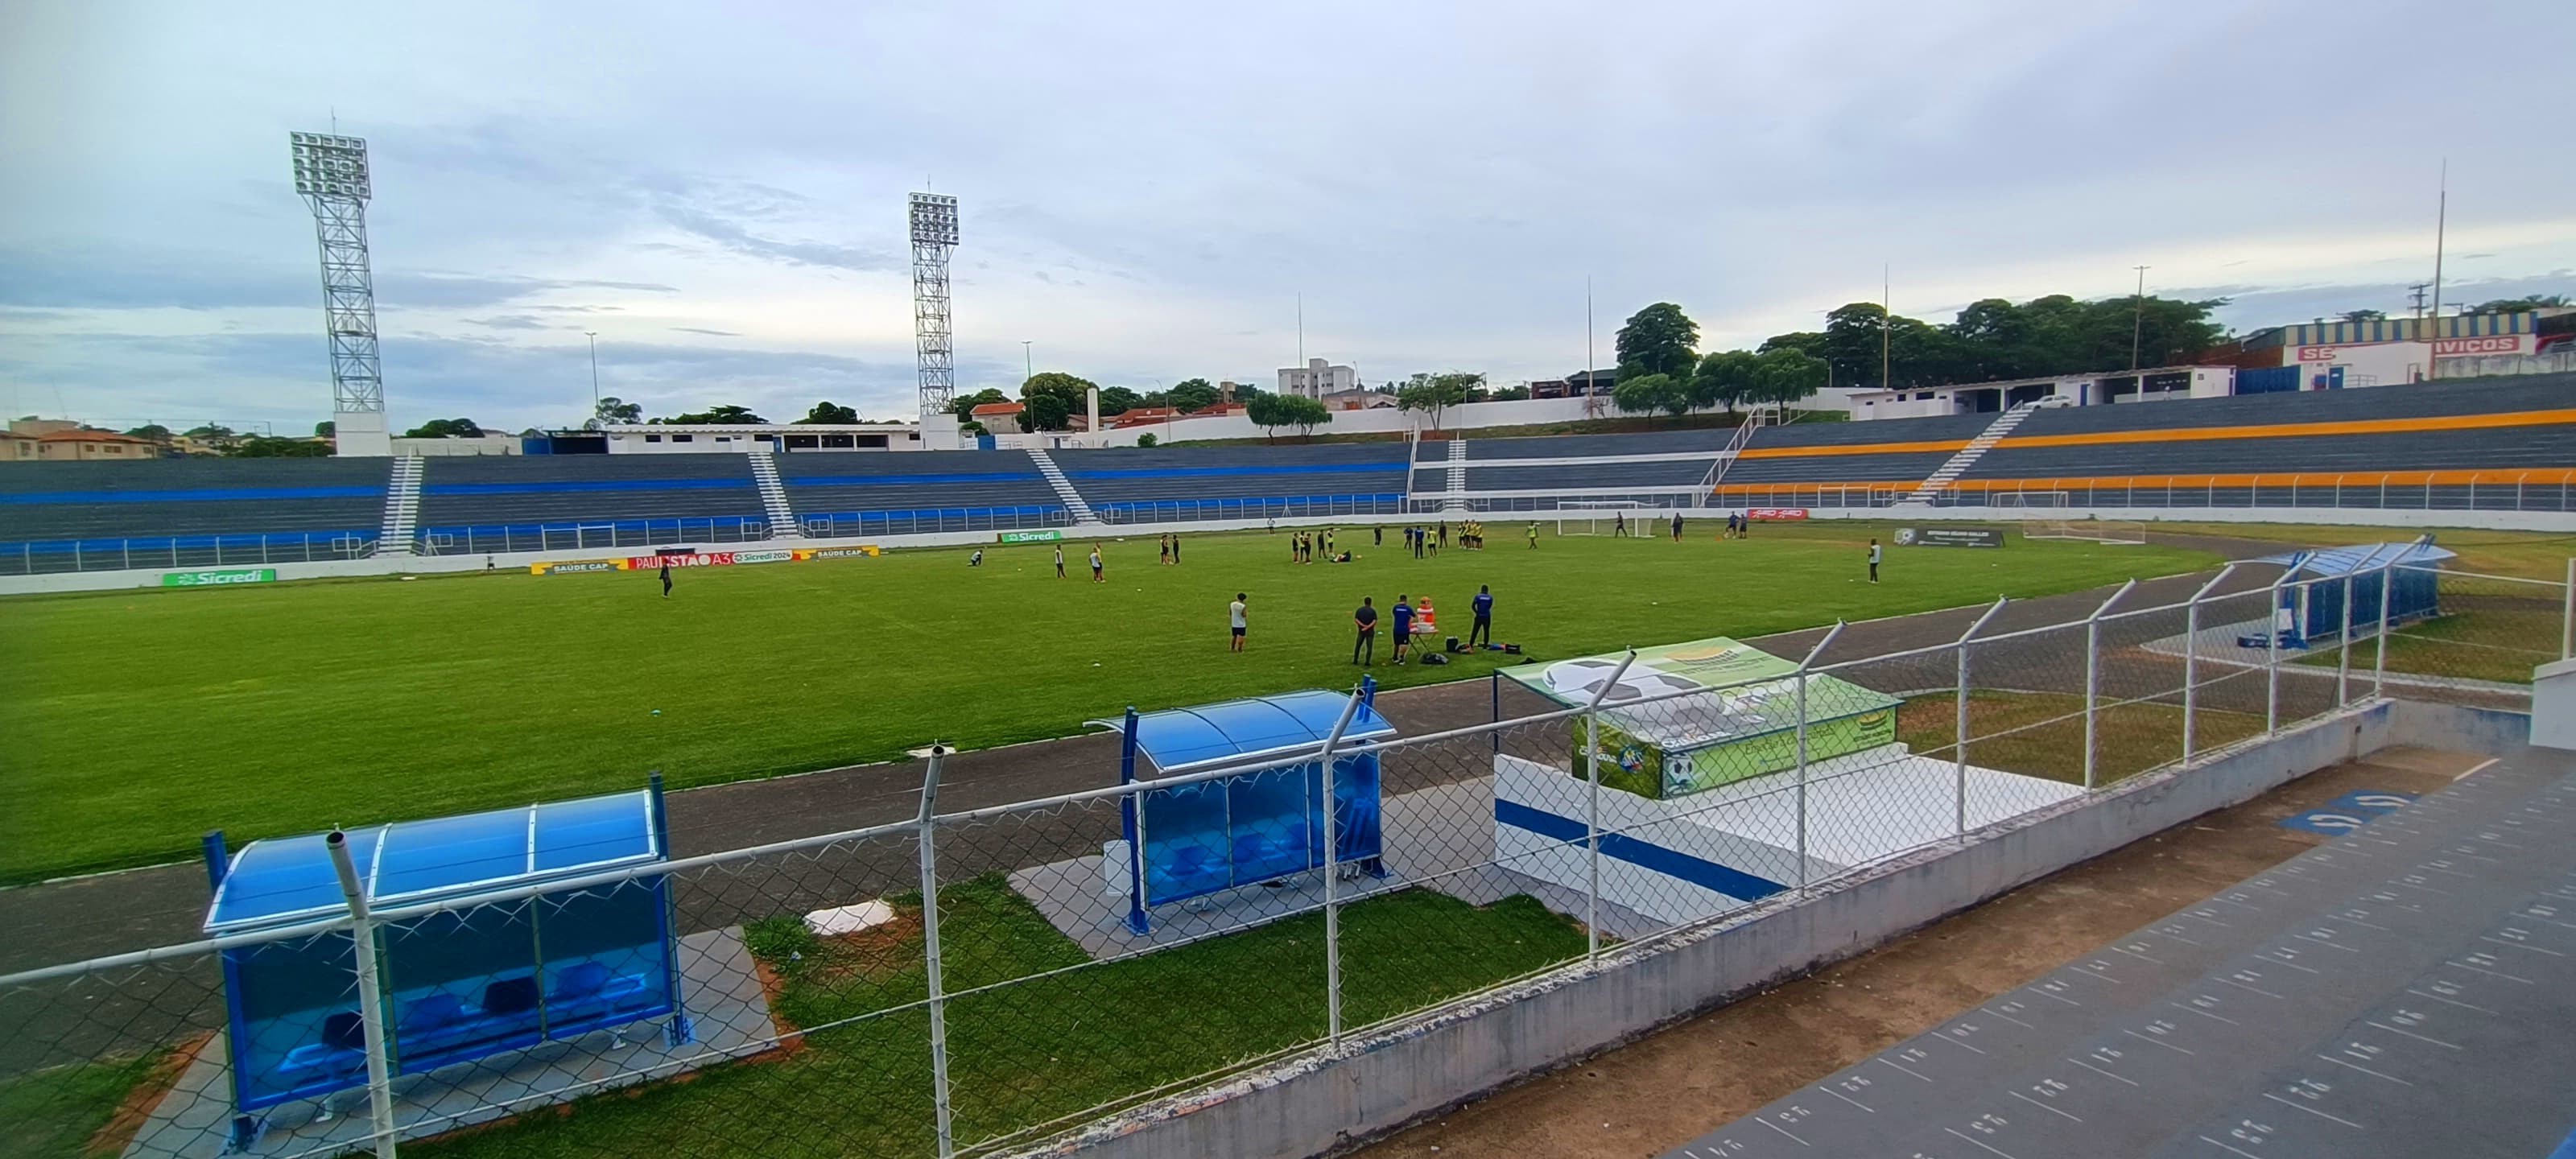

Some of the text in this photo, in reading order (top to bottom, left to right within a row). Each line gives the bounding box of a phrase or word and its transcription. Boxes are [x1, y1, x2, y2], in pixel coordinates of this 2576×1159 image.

[1019, 531, 1055, 541] Sicredi
[712, 553, 731, 565] A3
[744, 551, 791, 561] Sicredi 2024
[845, 549, 862, 557] CAP
[588, 563, 609, 571] CAP
[197, 570, 262, 585] Sicredi
[2273, 947, 2301, 959] 17
[2466, 952, 2498, 966] 18
[2233, 969, 2261, 982] 18
[2431, 980, 2466, 995] 19
[2192, 995, 2220, 1007] 19
[2391, 1008, 2426, 1026] 20
[1951, 1022, 1980, 1037] 20
[2145, 1020, 2176, 1035] 20
[1900, 1048, 1927, 1063] 21
[2091, 1047, 2123, 1063] 21
[2343, 1042, 2383, 1060] 21
[1840, 1075, 1872, 1092] 22
[2033, 1079, 2069, 1097] 22
[2289, 1079, 2332, 1099] 22
[1779, 1105, 1811, 1124] 23
[1971, 1114, 2008, 1134] 23
[2231, 1120, 2274, 1145] 23
[1707, 1139, 1744, 1157] 24
